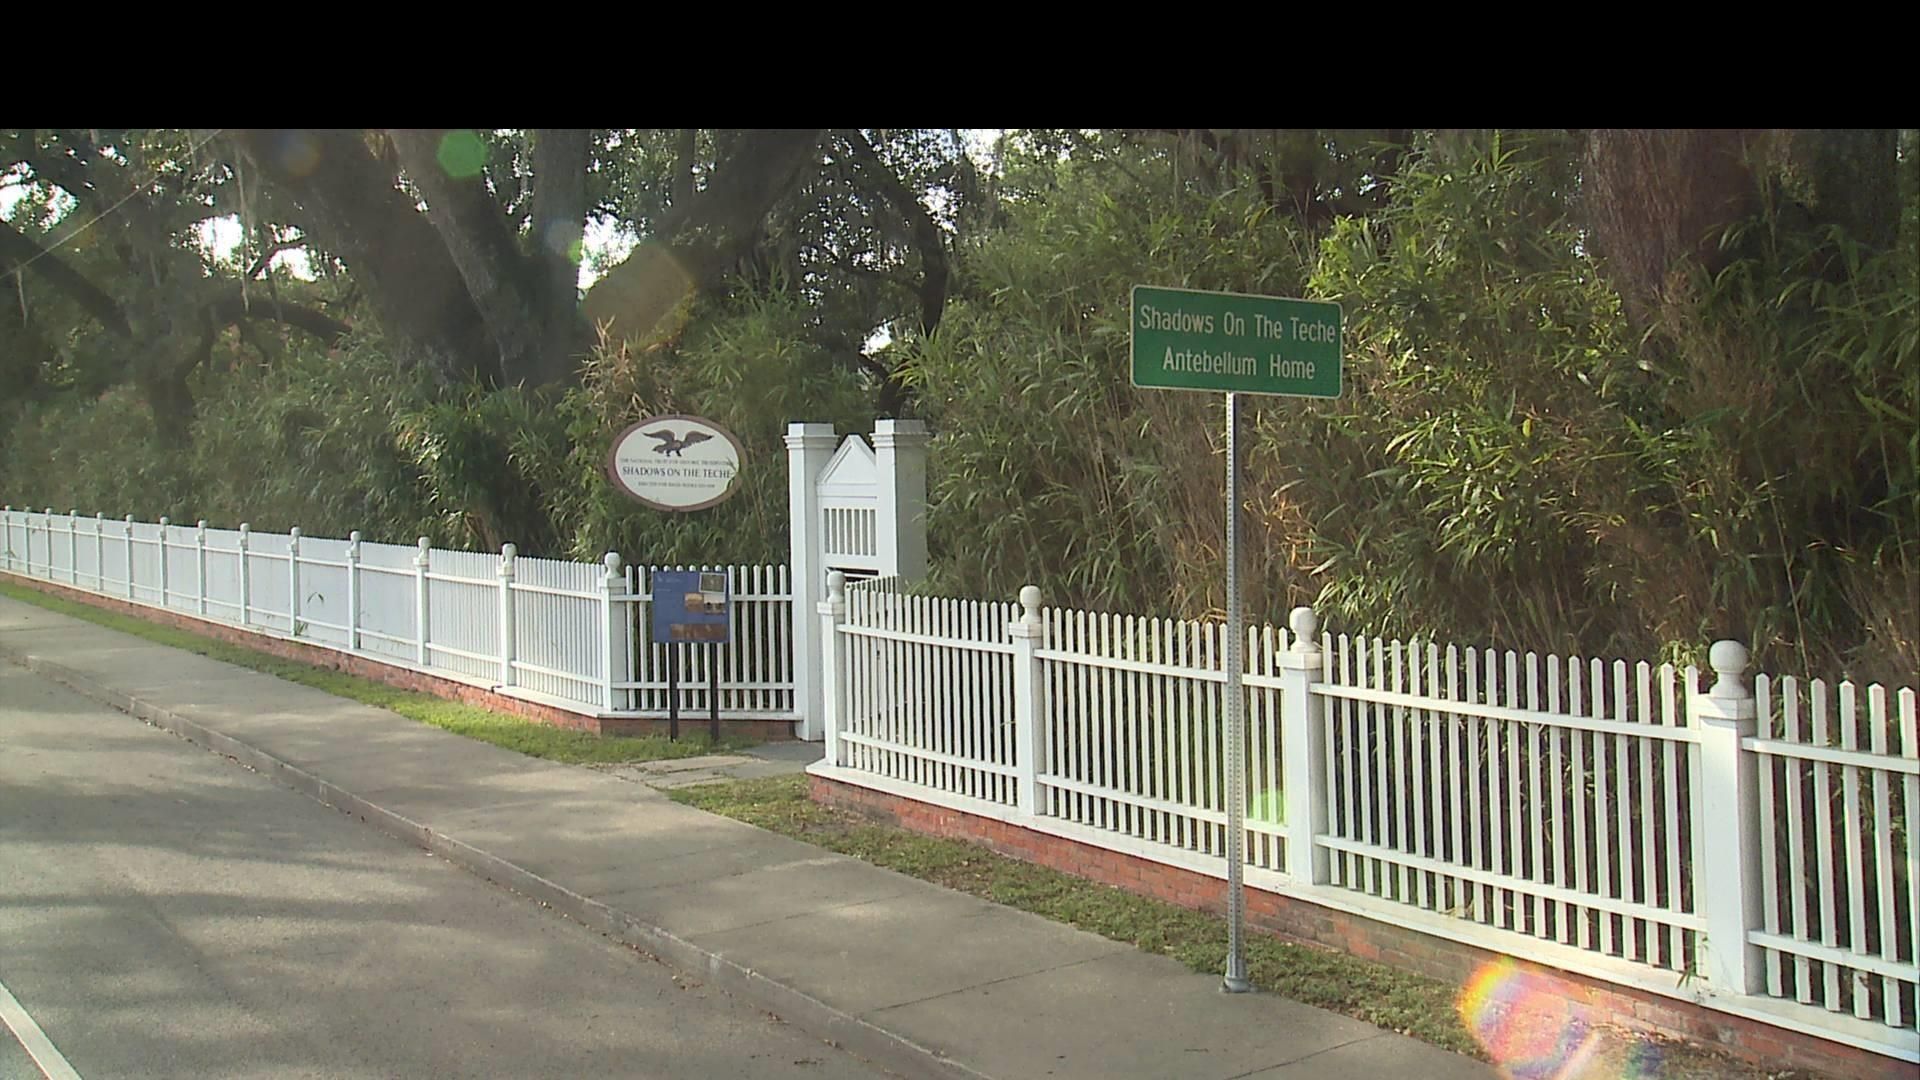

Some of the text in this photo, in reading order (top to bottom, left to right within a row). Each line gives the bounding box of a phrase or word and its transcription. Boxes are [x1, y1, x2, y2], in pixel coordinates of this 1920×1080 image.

[1139, 304, 1336, 343] Shadows On The Teche
[1162, 346, 1316, 380] Antebellum Home
[622, 466, 666, 477] SHADOWS
[667, 467, 681, 477] ON
[683, 468, 700, 478] THE
